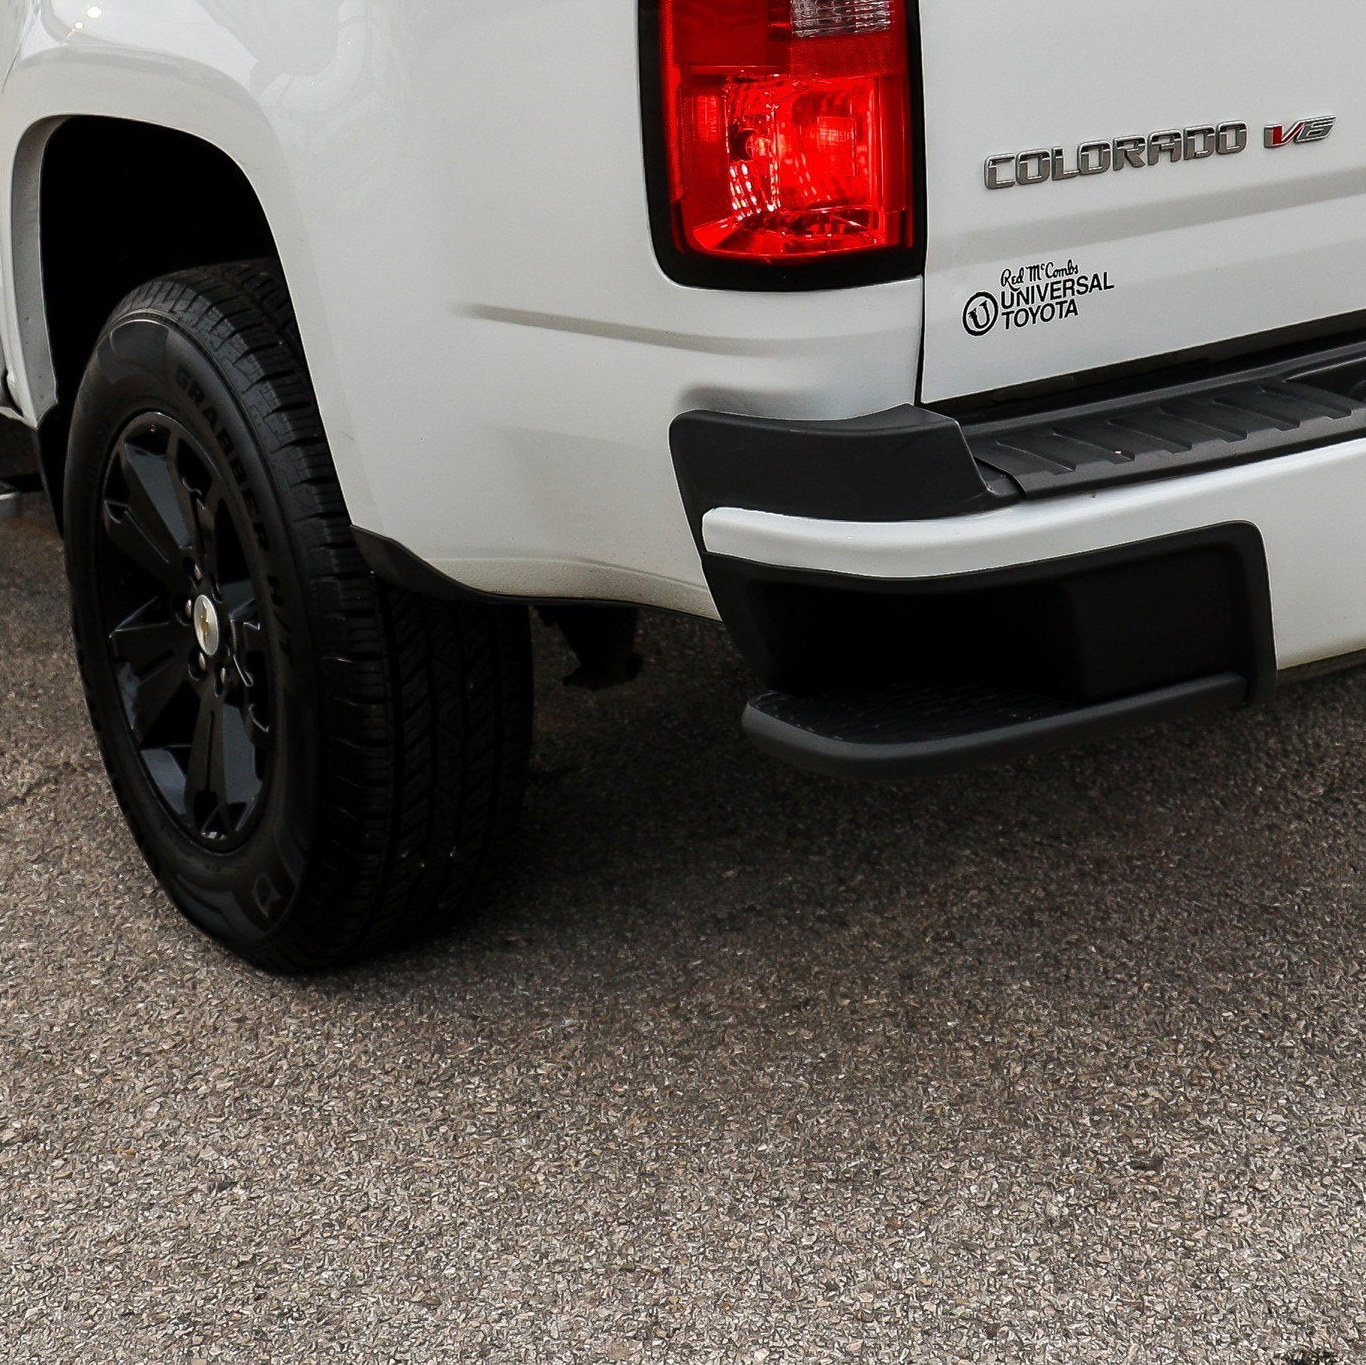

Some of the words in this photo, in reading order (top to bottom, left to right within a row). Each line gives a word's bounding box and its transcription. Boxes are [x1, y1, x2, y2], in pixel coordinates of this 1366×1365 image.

[984, 119, 1247, 190] COLORADO
[1263, 114, 1337, 150] V6
[1001, 267, 1024, 292] Red
[1001, 272, 1115, 310] UNIVERSAL
[1001, 299, 1079, 330] TOYOTA
